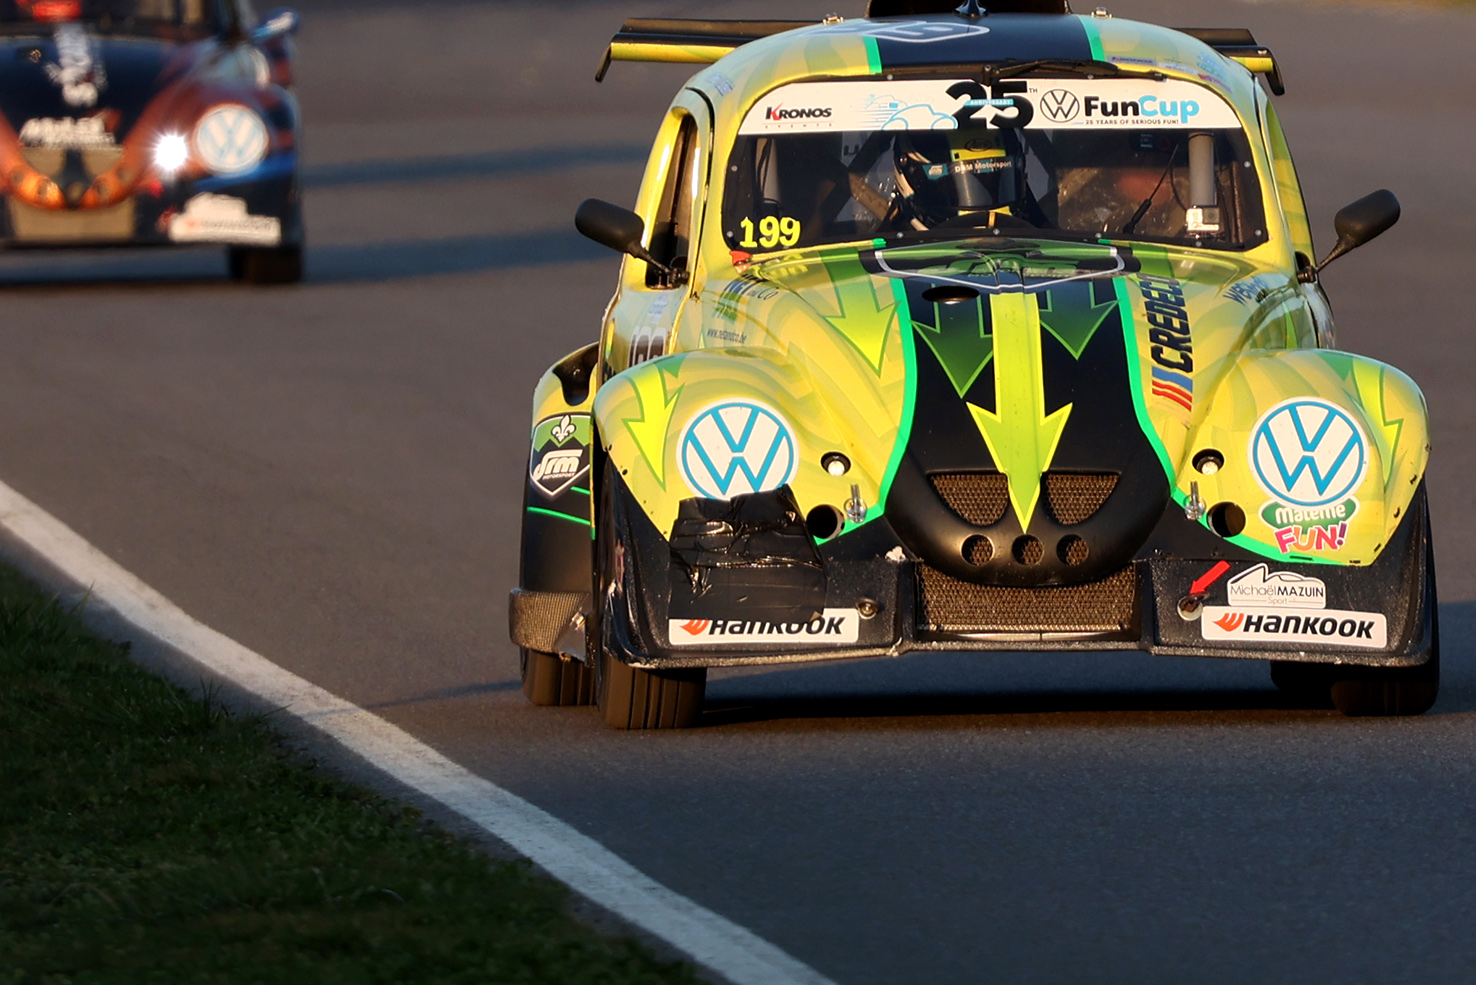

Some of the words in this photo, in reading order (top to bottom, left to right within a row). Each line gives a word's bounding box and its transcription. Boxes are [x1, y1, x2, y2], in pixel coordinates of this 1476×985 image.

[765, 102, 832, 121] KRONOS
[945, 81, 1034, 128] 25
[1084, 95, 1199, 123] FunCup
[739, 216, 800, 248] 199
[1137, 273, 1193, 373] CREDECO
[1273, 521, 1348, 553] FUN!
